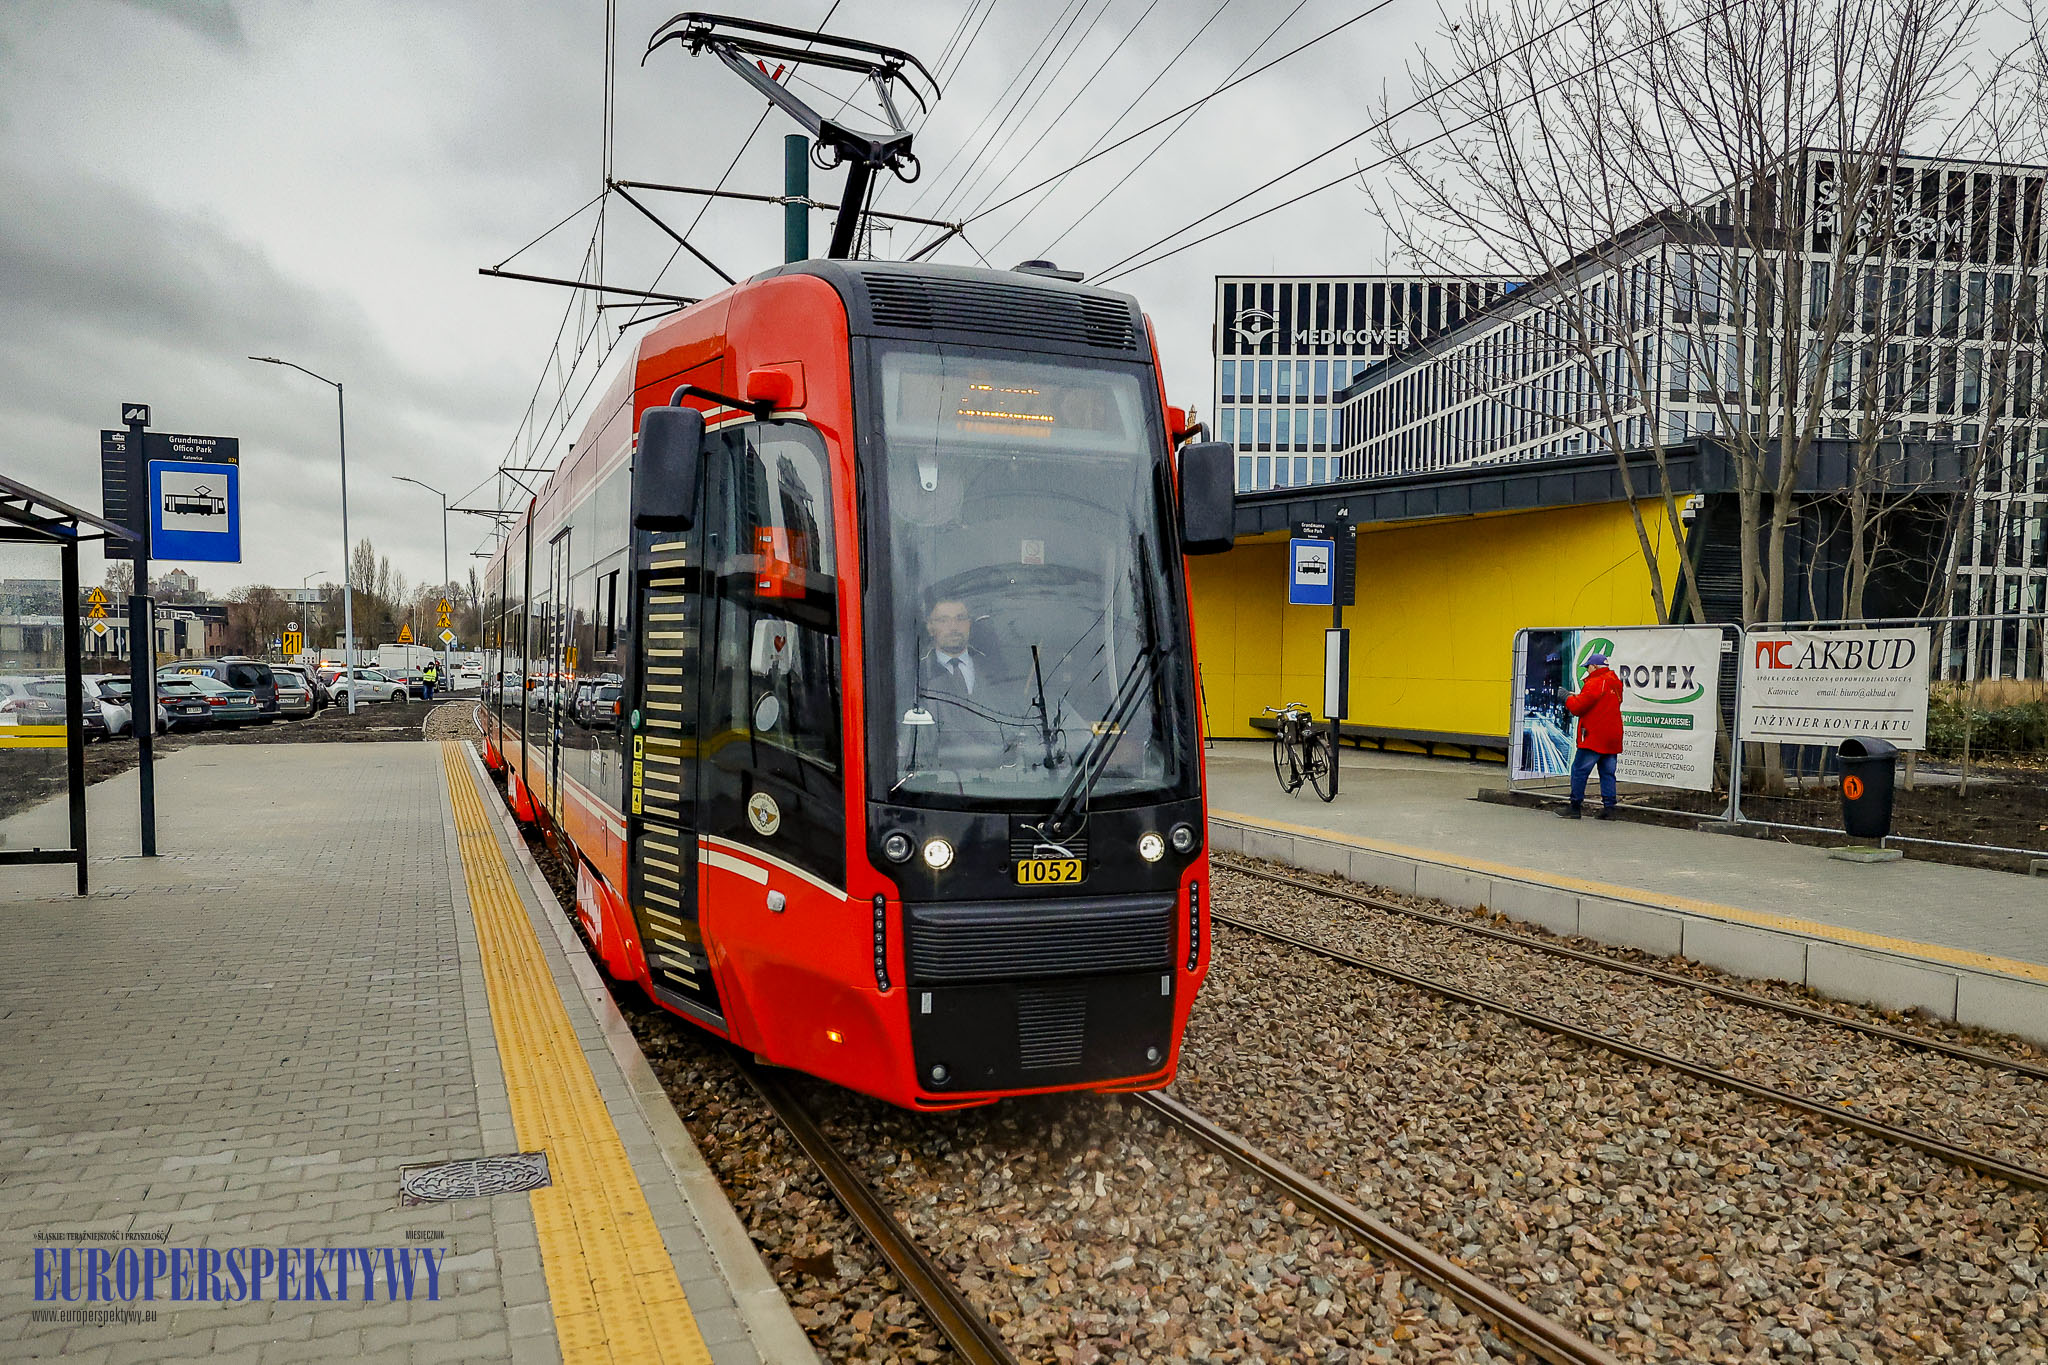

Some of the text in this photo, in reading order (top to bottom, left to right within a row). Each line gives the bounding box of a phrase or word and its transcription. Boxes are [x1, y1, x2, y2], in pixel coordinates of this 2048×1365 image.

[1291, 329, 1411, 345] MEDICOVER
[169, 436, 217, 446] Grundmanna
[173, 444, 212, 453] Office Park
[1795, 638, 1916, 670] AKBUD
[1767, 686, 1799, 696] Katowice
[1816, 688, 1838, 697] email:
[1653, 717, 1660, 725] W
[1660, 717, 1691, 726] ZAKRESIE:
[1754, 714, 1911, 731] INŻYNIER KONTRAKTU
[1624, 730, 1663, 739] ROJEKTOWANIA
[1021, 861, 1078, 882] 1052
